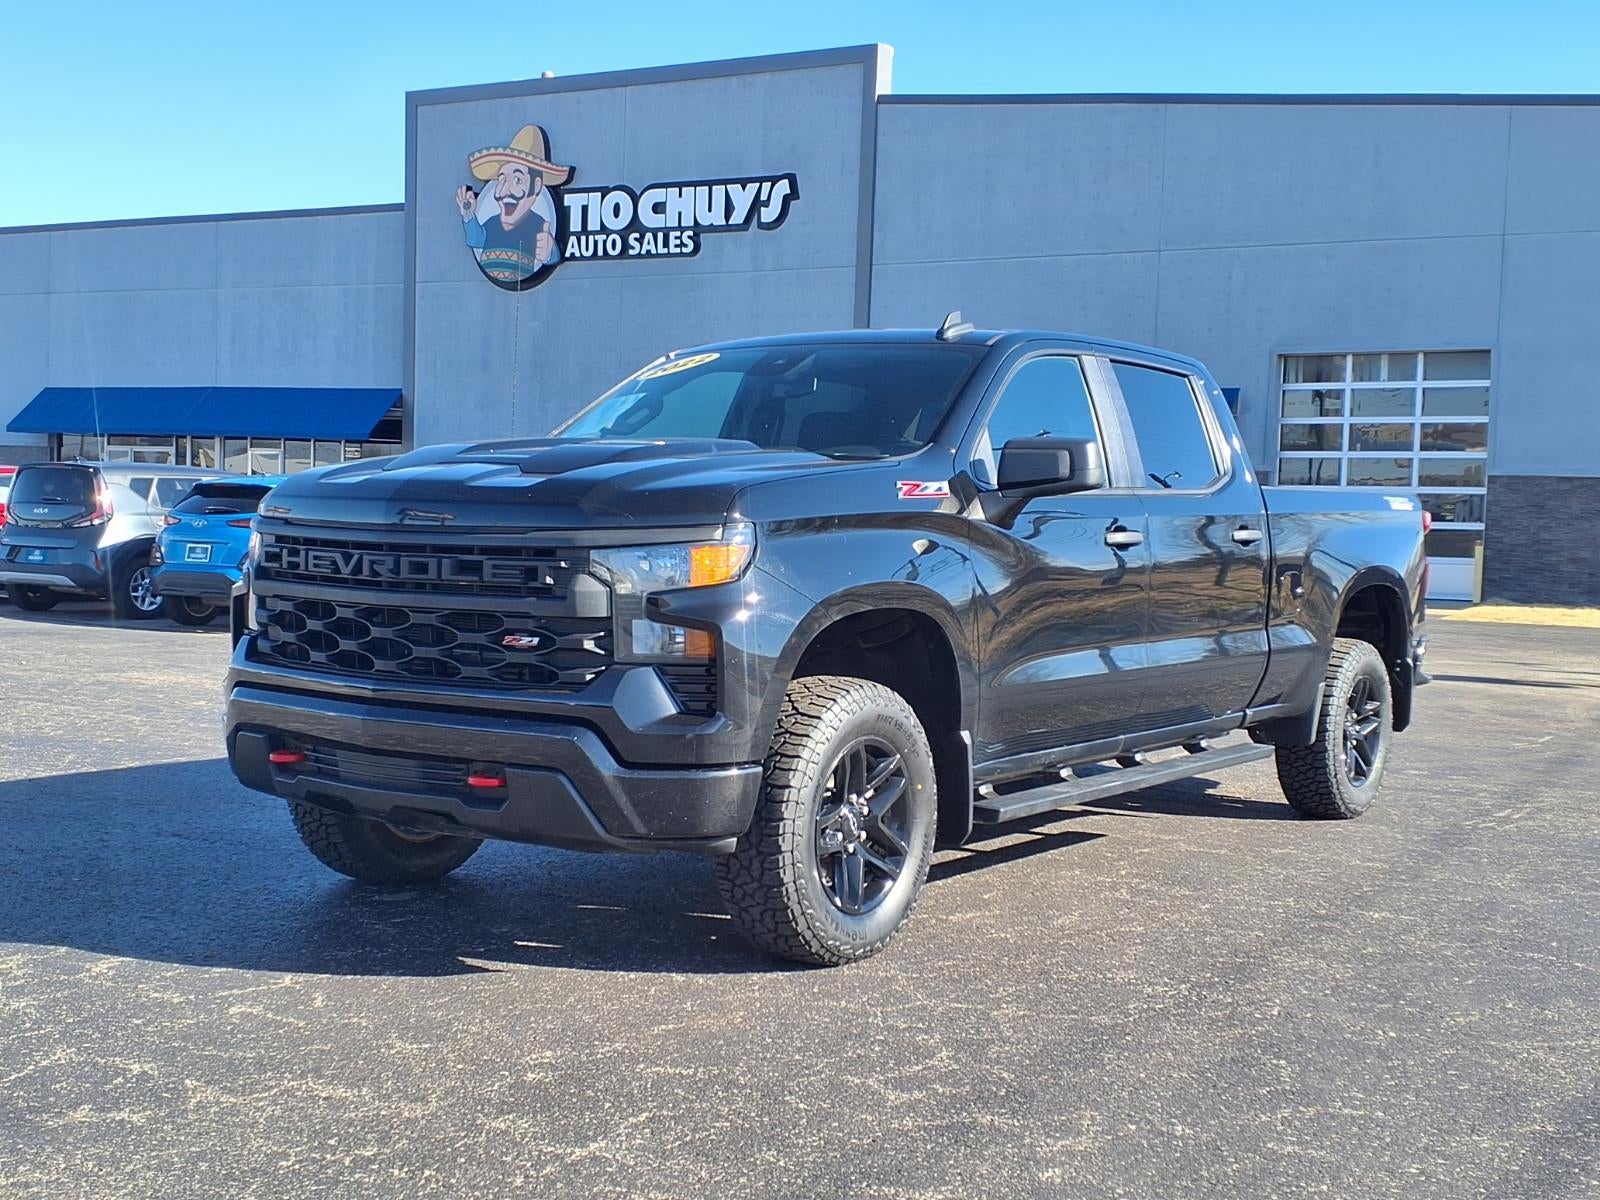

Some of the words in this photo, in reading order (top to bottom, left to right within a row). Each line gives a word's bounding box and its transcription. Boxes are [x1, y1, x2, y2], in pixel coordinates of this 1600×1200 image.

[564, 190, 633, 232] TIO
[637, 179, 790, 227] CHUY'S
[564, 233, 622, 258] AUTO
[628, 230, 695, 255] SALES
[260, 547, 562, 584] CHEVROLET
